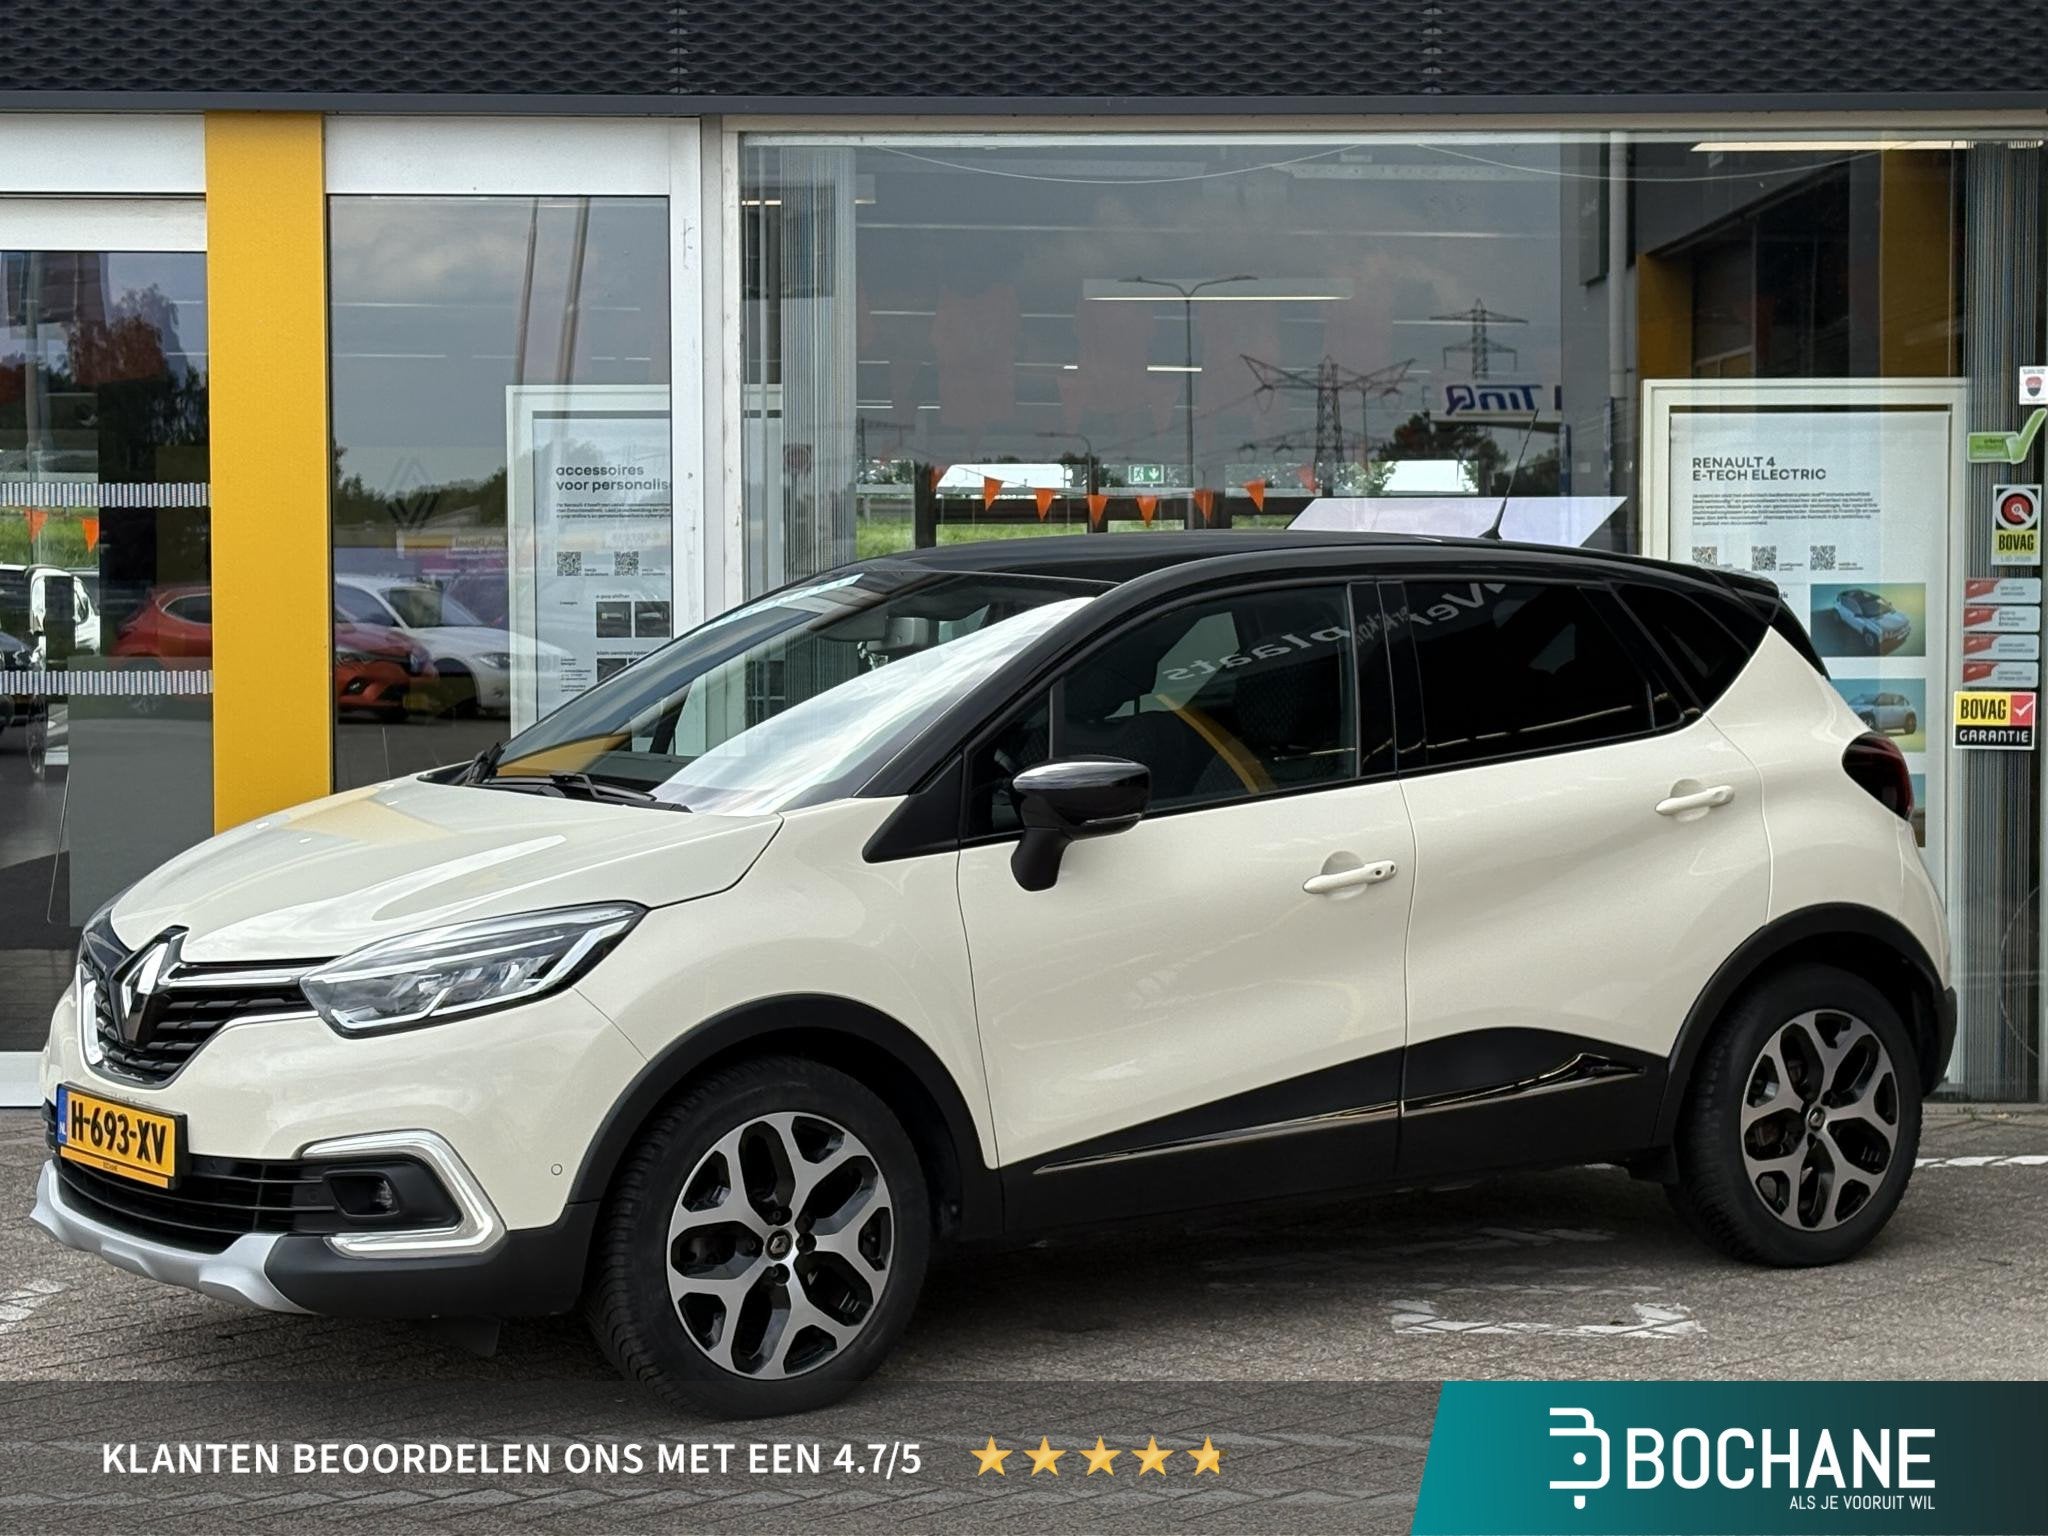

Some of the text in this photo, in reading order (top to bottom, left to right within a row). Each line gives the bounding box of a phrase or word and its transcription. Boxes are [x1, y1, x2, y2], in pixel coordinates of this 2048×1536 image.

[1692, 457, 1776, 468] RENAULT 4
[556, 464, 644, 476] accessoires
[1692, 469, 1827, 481] E-TECH ELECTRIC
[556, 481, 589, 491] voor
[1998, 534, 2034, 551] BOVAG
[1960, 698, 2007, 720] BOVAG
[1959, 729, 2030, 743] GARANTIE
[71, 1100, 167, 1166] H-693-XV
